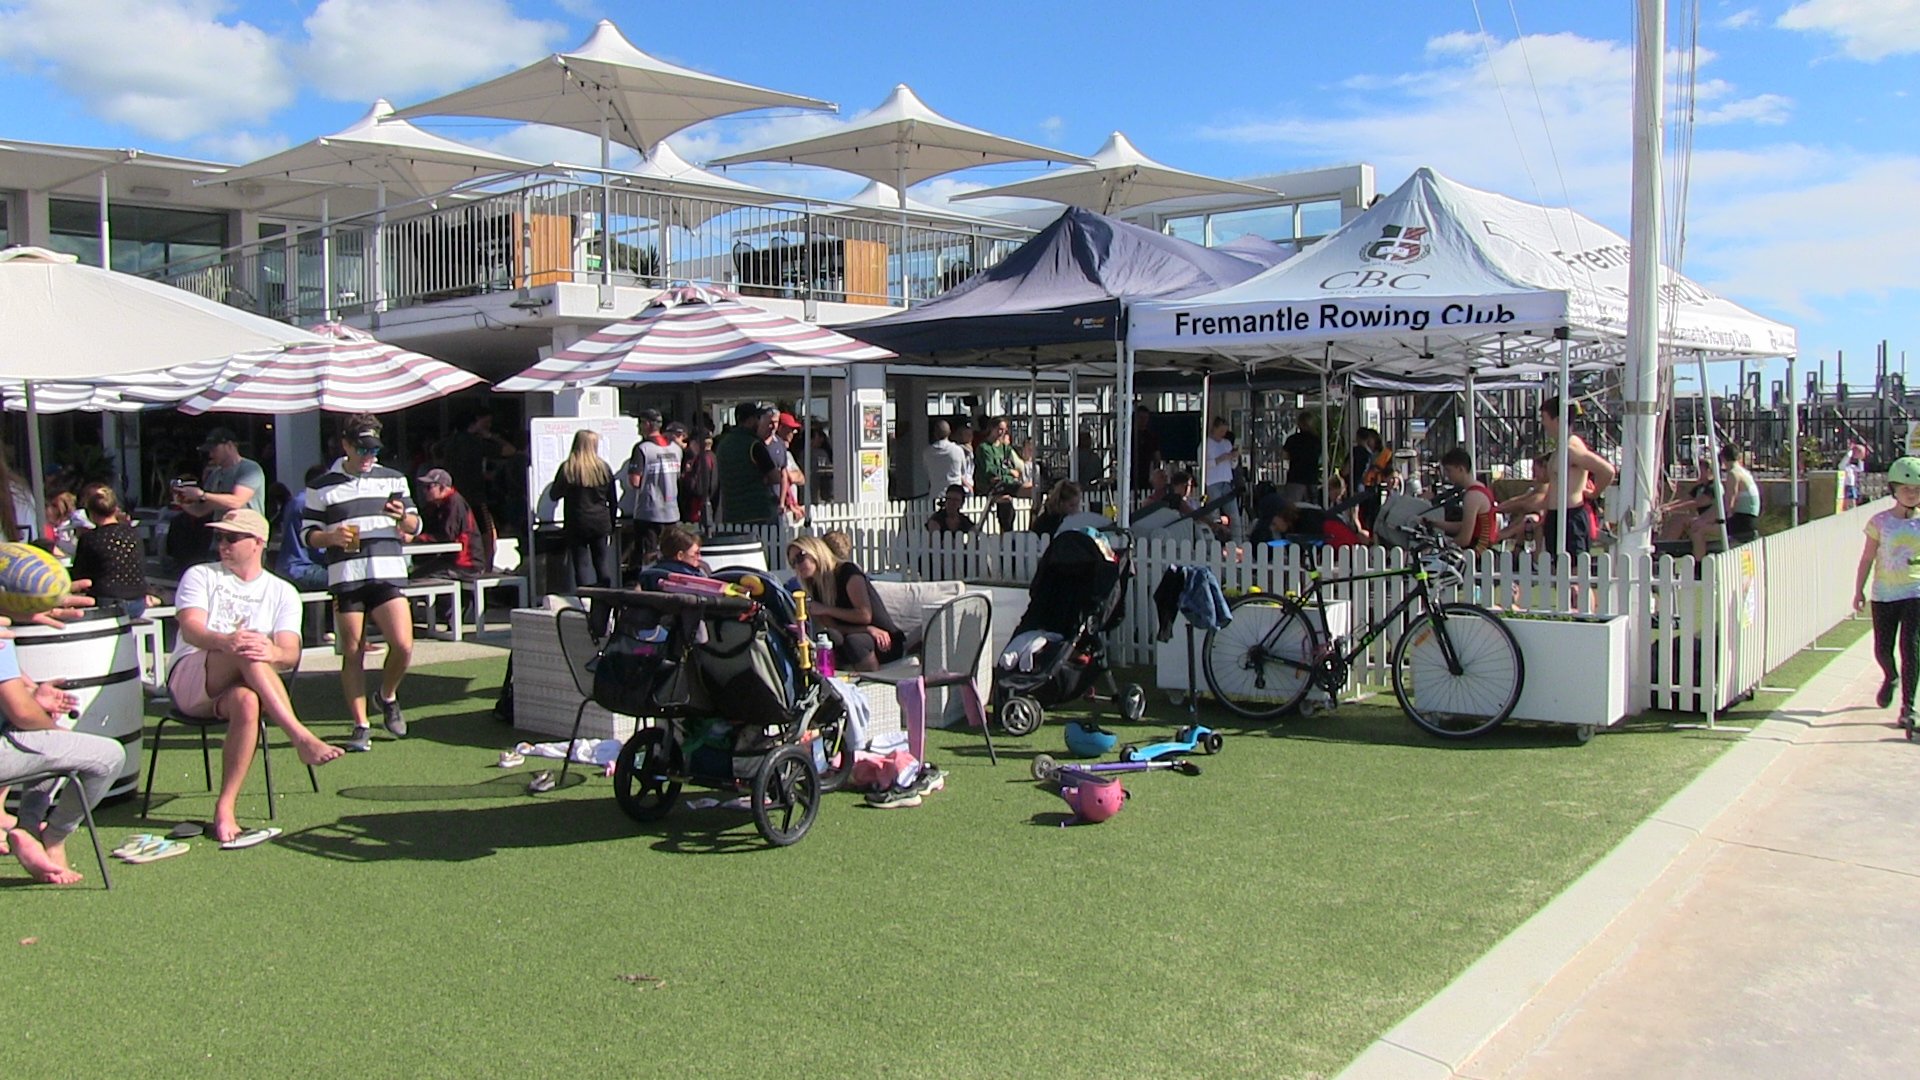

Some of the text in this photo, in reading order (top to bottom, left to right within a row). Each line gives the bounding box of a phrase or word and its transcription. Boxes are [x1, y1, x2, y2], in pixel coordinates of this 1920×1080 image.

[1319, 270, 1430, 290] CBC
[1175, 303, 1515, 336] Fremantle Rowing Club
